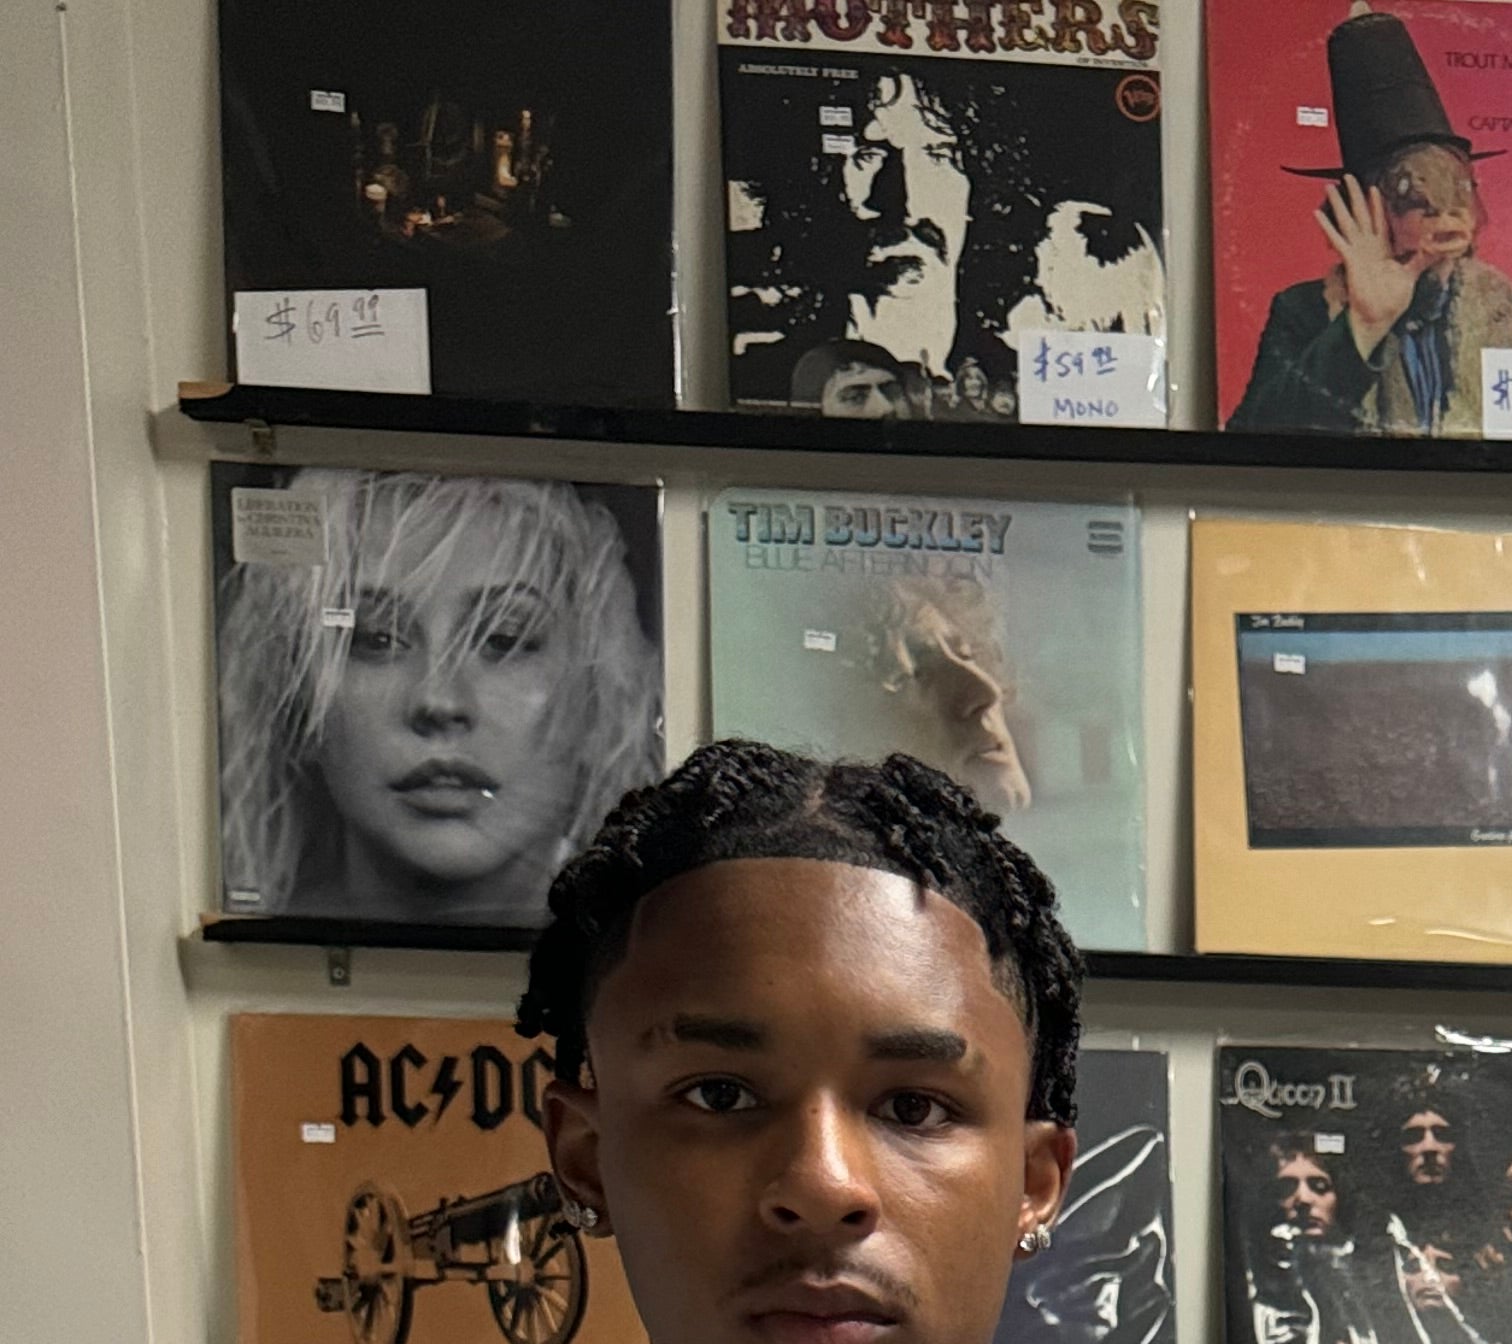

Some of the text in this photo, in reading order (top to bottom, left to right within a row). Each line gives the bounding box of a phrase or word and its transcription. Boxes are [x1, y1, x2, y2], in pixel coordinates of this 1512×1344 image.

[1445, 51, 1497, 69] TROUT
[1053, 398, 1119, 419] MONO
[728, 502, 1013, 556] TIM BUCKLEY
[745, 543, 995, 577] BLUE AFTERNOON
